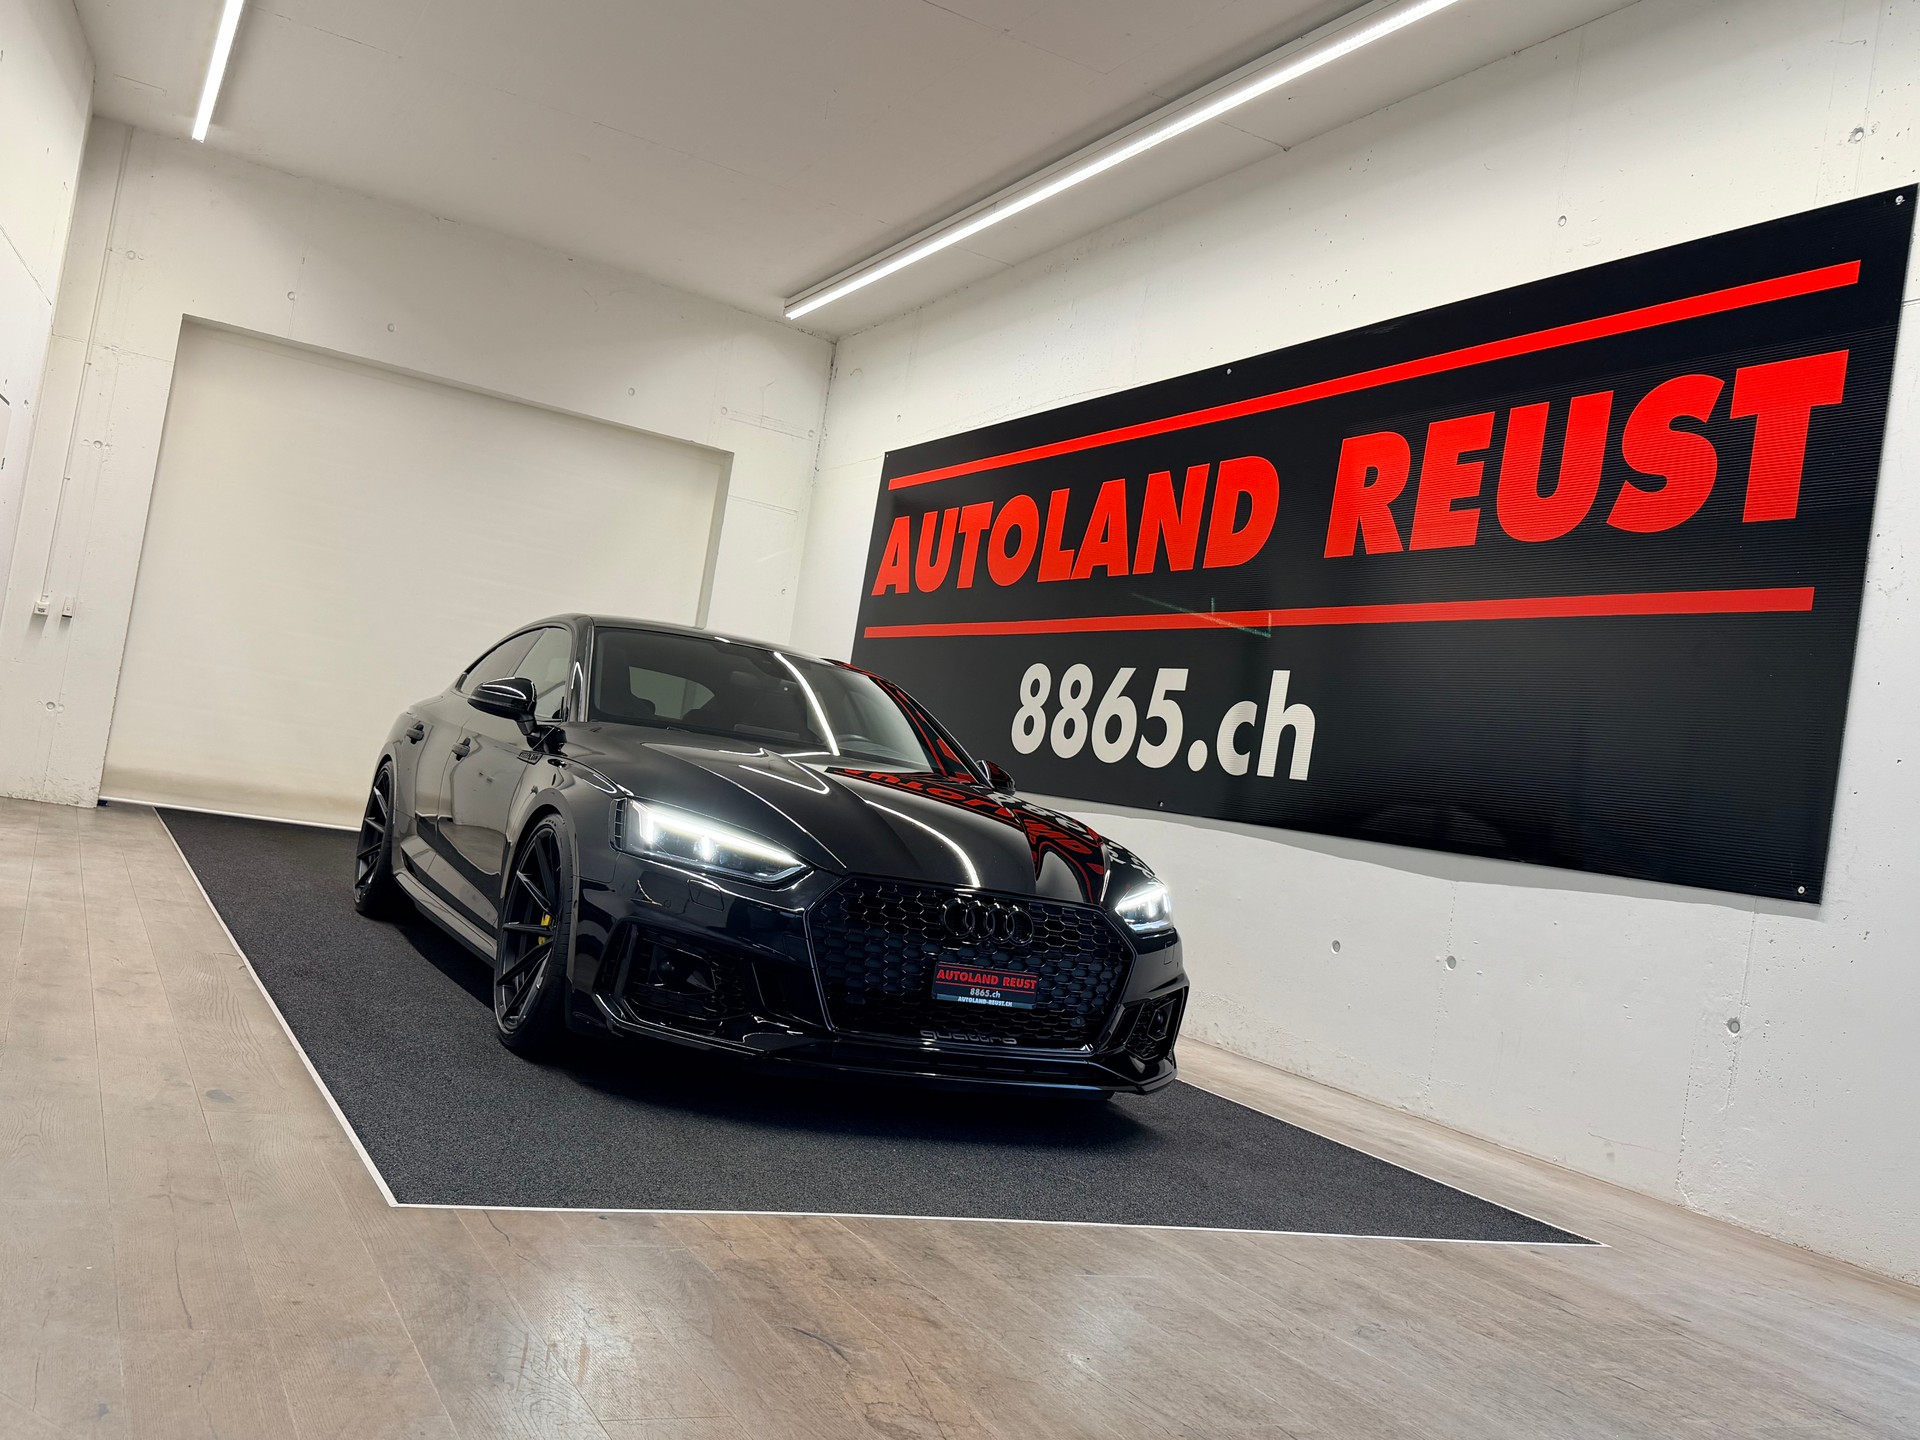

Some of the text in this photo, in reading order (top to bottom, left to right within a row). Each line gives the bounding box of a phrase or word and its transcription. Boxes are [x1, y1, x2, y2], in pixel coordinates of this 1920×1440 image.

[872, 350, 1850, 595] AUTOLAND REUST
[1012, 663, 1316, 781] 8865.ch
[937, 970, 1037, 989] AUTOLAND REUST
[958, 996, 1013, 1007] AUTOLAND-REUST.CH
[970, 988, 1001, 998] 8865.ch
[920, 1030, 1017, 1045] quattro
